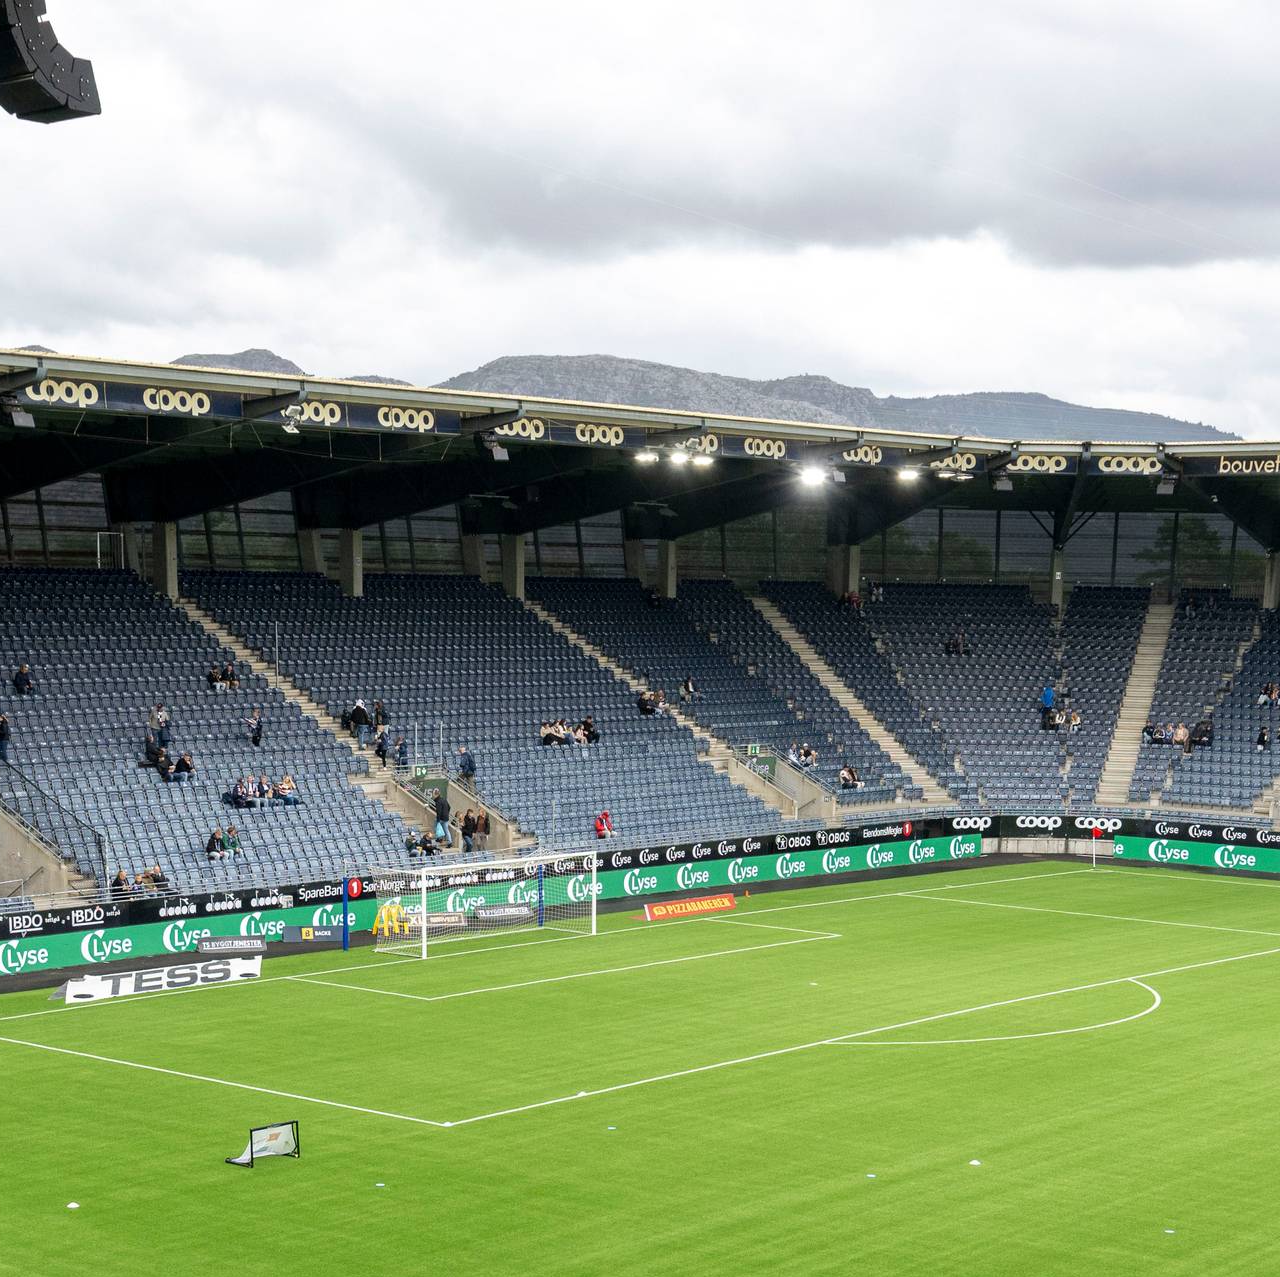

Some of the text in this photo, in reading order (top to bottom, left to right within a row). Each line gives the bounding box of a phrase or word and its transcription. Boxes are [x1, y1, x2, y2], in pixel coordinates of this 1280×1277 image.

[143, 387, 211, 416] coop
[282, 402, 341, 427] oop
[377, 406, 434, 434] coop
[576, 423, 624, 446] coop
[744, 437, 786, 459] coop
[930, 453, 977, 472] op
[1098, 455, 1162, 475] coop
[952, 816, 992, 831] coop
[1016, 815, 1063, 830] coop
[1075, 816, 1122, 832] coop
[1160, 823, 1179, 835] Lyse
[829, 832, 850, 843] OBOS
[1194, 826, 1213, 838] Lyse
[1228, 828, 1247, 841] Lyse
[1262, 832, 1280, 845] Lyse
[722, 843, 736, 855] Lyse
[746, 840, 761, 852] Lyse
[788, 835, 811, 848] OBOS
[955, 840, 976, 858] Lyse
[617, 854, 632, 866] Lyse
[645, 852, 659, 863] Lyse
[671, 848, 686, 860] Lyse
[697, 846, 711, 858] Lyse
[872, 850, 894, 867] Lyse
[915, 845, 935, 863] Lyse
[1158, 842, 1189, 861] Lyse
[1224, 848, 1256, 868] Lyse
[783, 859, 806, 877] Lyse
[829, 855, 851, 872] Lyse
[684, 869, 710, 888] Lyse
[735, 864, 759, 882] Lyse
[299, 884, 346, 900] SpareBan
[631, 875, 657, 894] Lyse
[454, 894, 486, 912] Lyse
[517, 888, 544, 904] Lys
[12, 914, 43, 930] BDO
[74, 908, 105, 923] BDO
[251, 916, 286, 936] Lyse
[176, 926, 211, 951] Lyse
[93, 936, 132, 961] Lyse
[7, 947, 49, 972] Lyse
[101, 960, 231, 996] TESS
